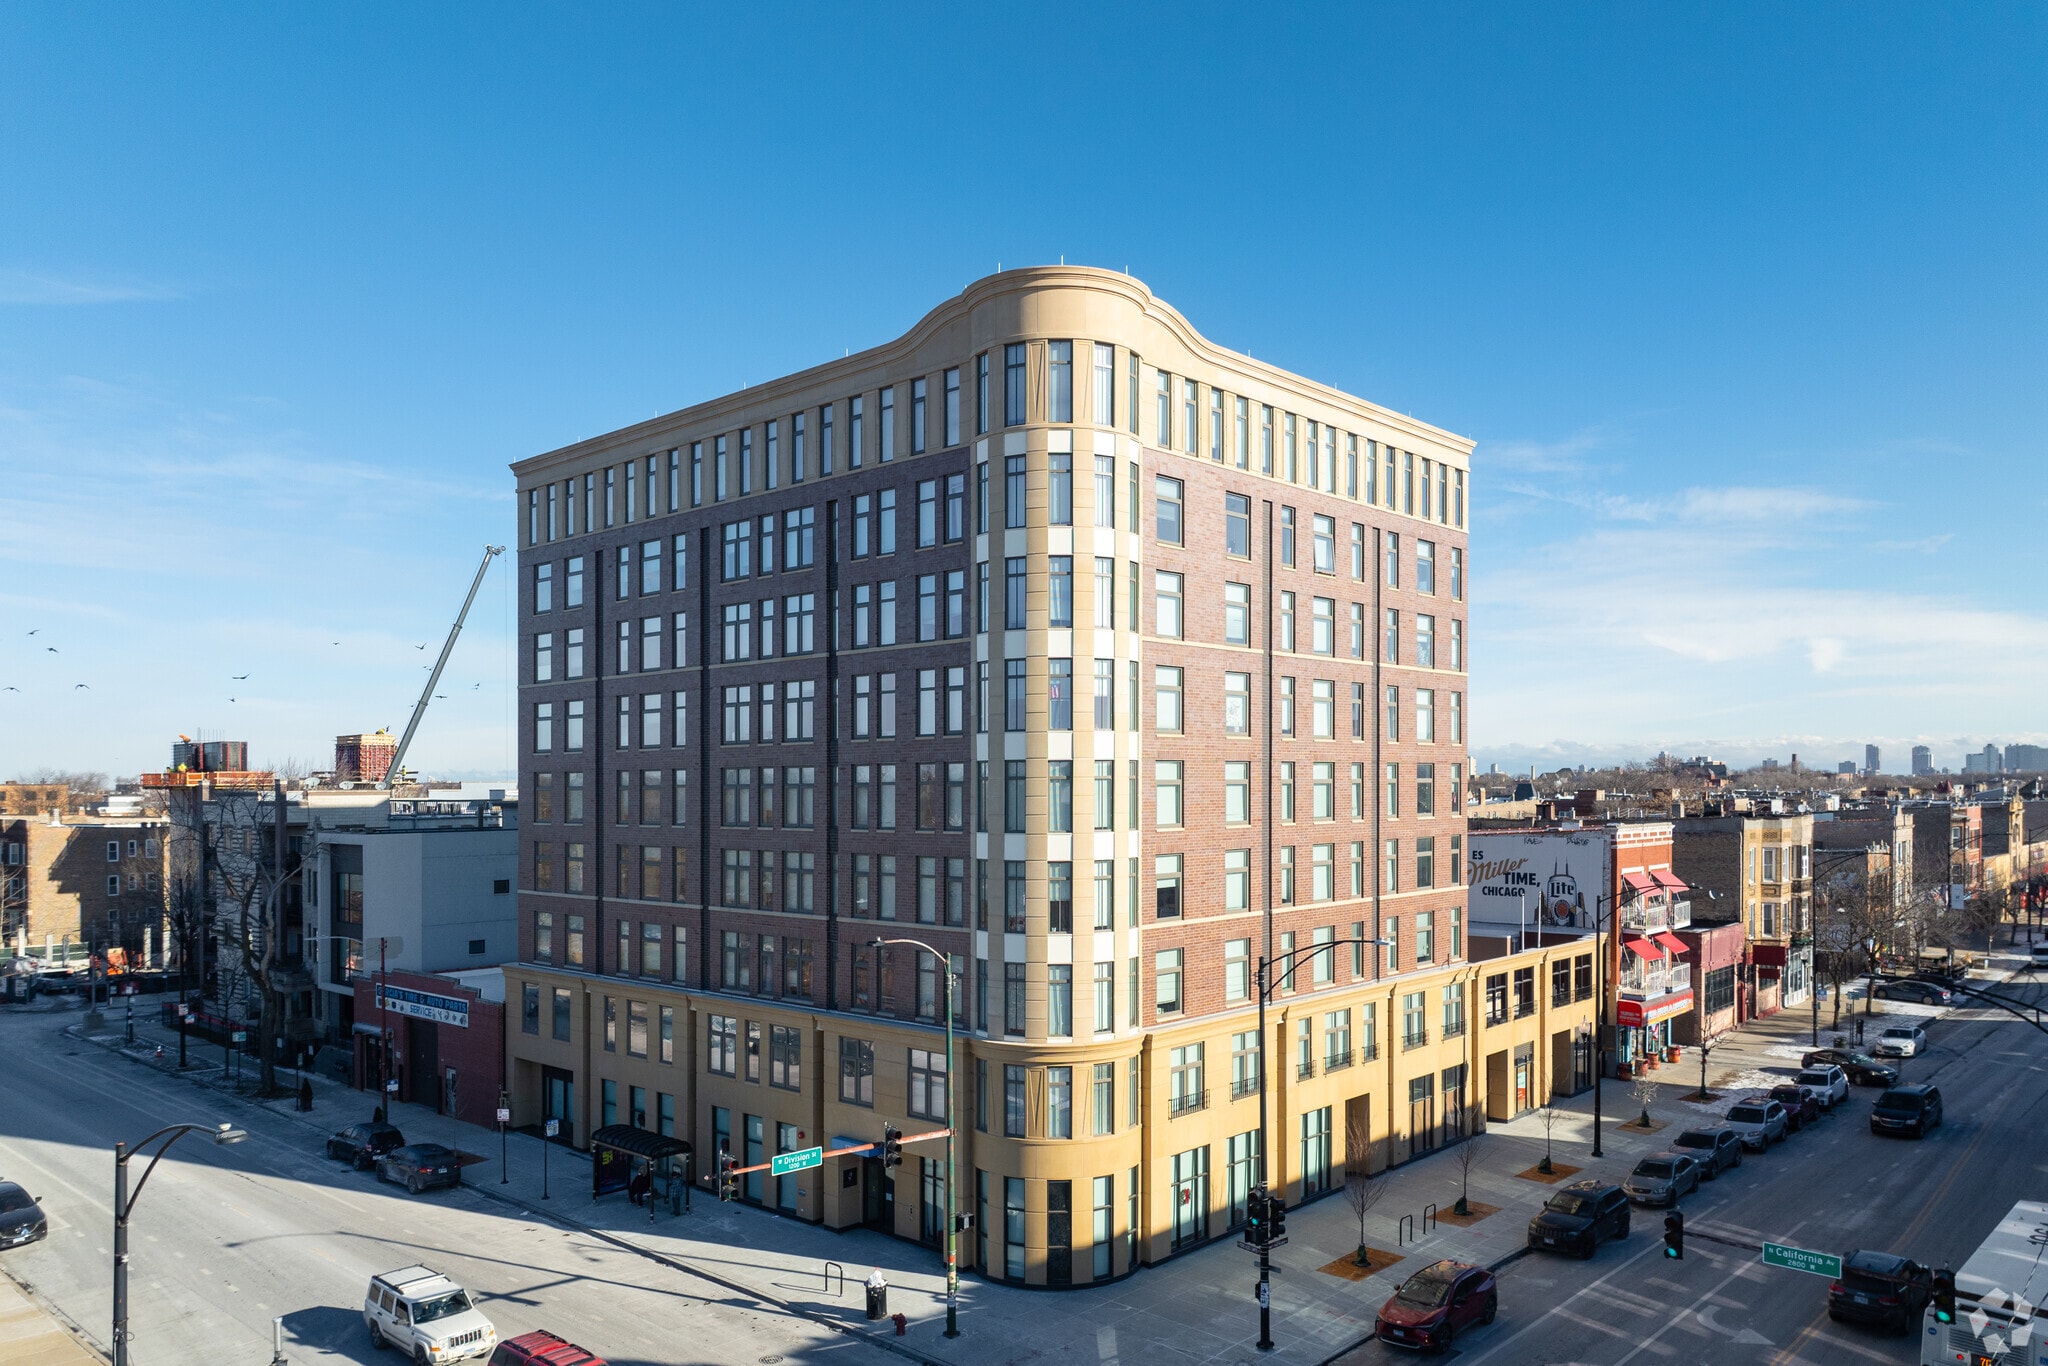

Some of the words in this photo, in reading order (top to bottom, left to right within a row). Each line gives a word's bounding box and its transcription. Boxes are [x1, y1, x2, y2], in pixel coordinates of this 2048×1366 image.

[1472, 850, 1484, 860] ES
[1468, 857, 1529, 887] Miller
[1504, 872, 1541, 888] TIME,
[1482, 886, 1525, 897] CHICAGO
[1550, 882, 1575, 898] Lite
[377, 986, 403, 998] GRCIA'S
[405, 992, 418, 1003] TIRE
[427, 996, 443, 1008] AUTO
[445, 999, 467, 1013] PARTS
[409, 1005, 432, 1017] SERVICE
[784, 1153, 810, 1164] Division
[1775, 1248, 1823, 1265] California
[1787, 1259, 1806, 1268] 2800
